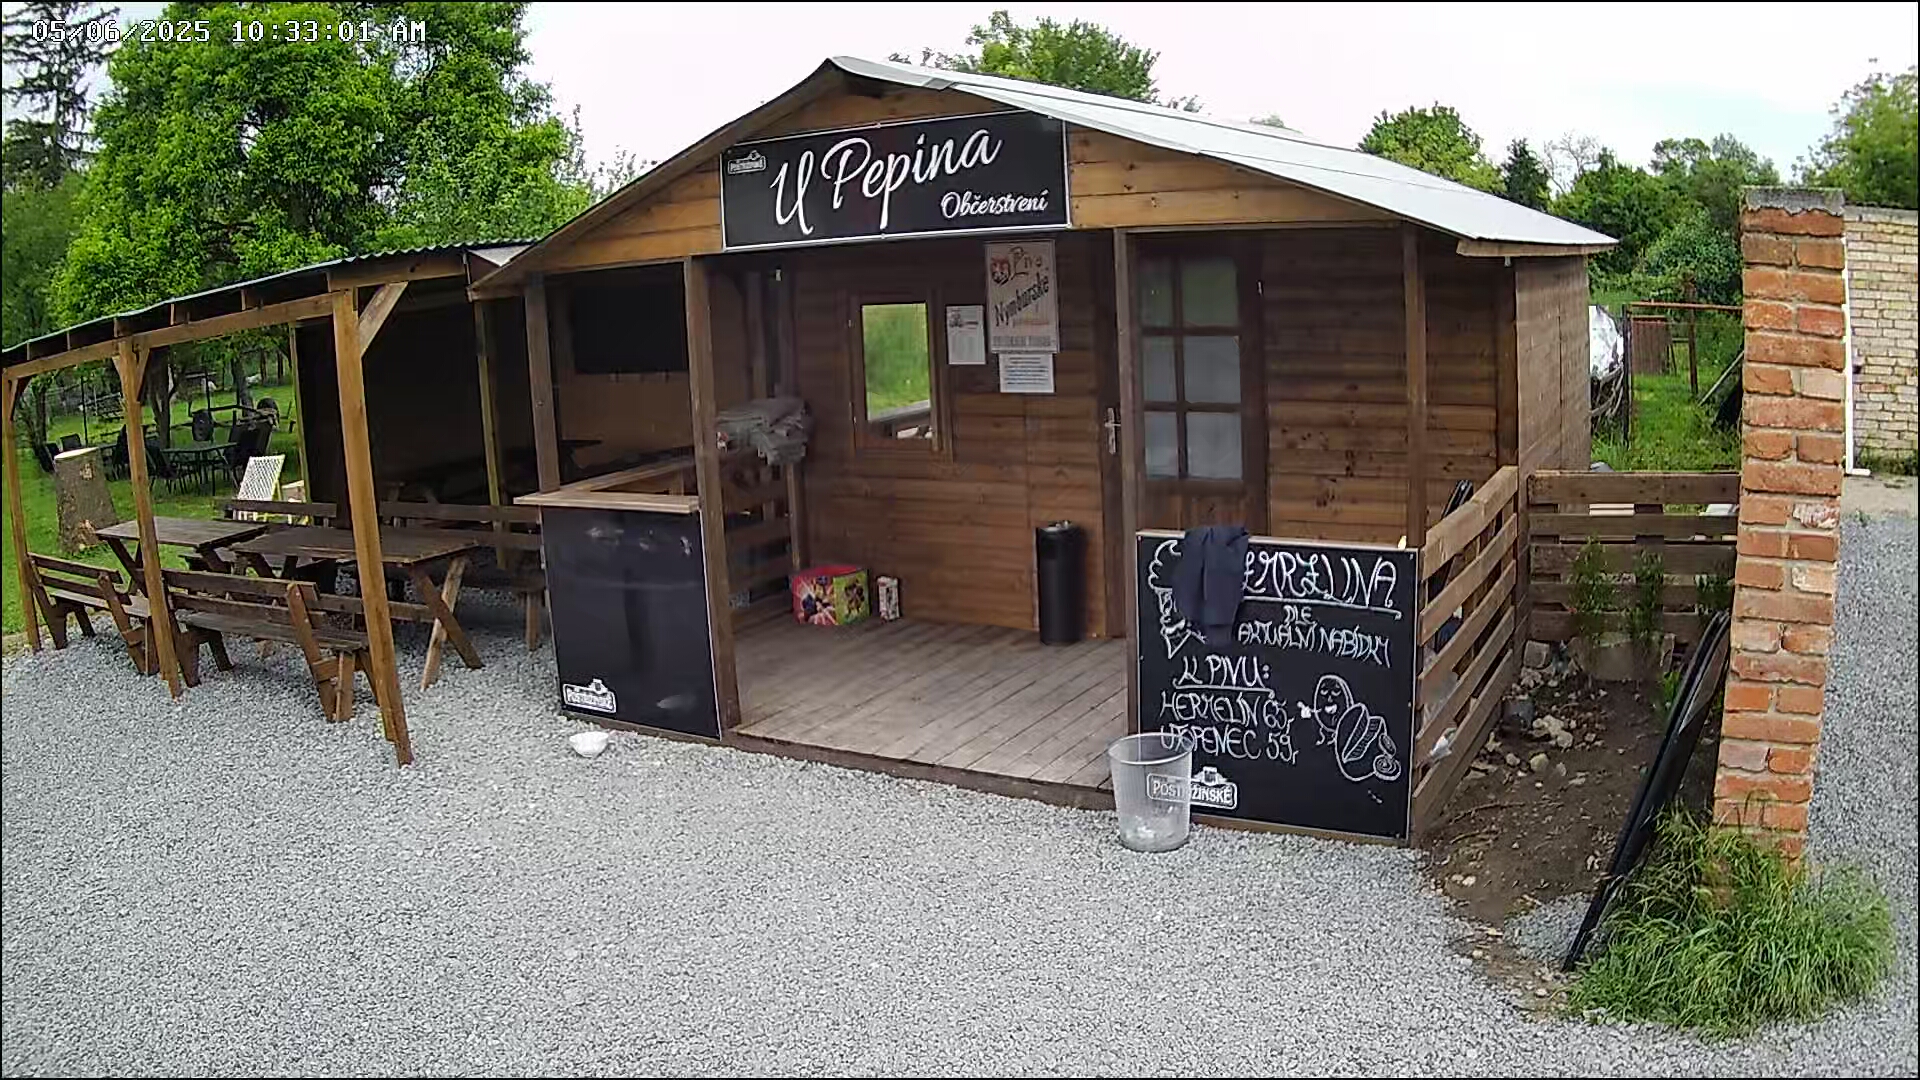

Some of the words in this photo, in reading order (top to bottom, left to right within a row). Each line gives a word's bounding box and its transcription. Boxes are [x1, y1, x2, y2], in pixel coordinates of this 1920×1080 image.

[769, 149, 817, 236] U
[820, 129, 1003, 230] Pepina
[940, 189, 1049, 220] Občerstvení
[1161, 692, 1261, 726] HERMELÍN
